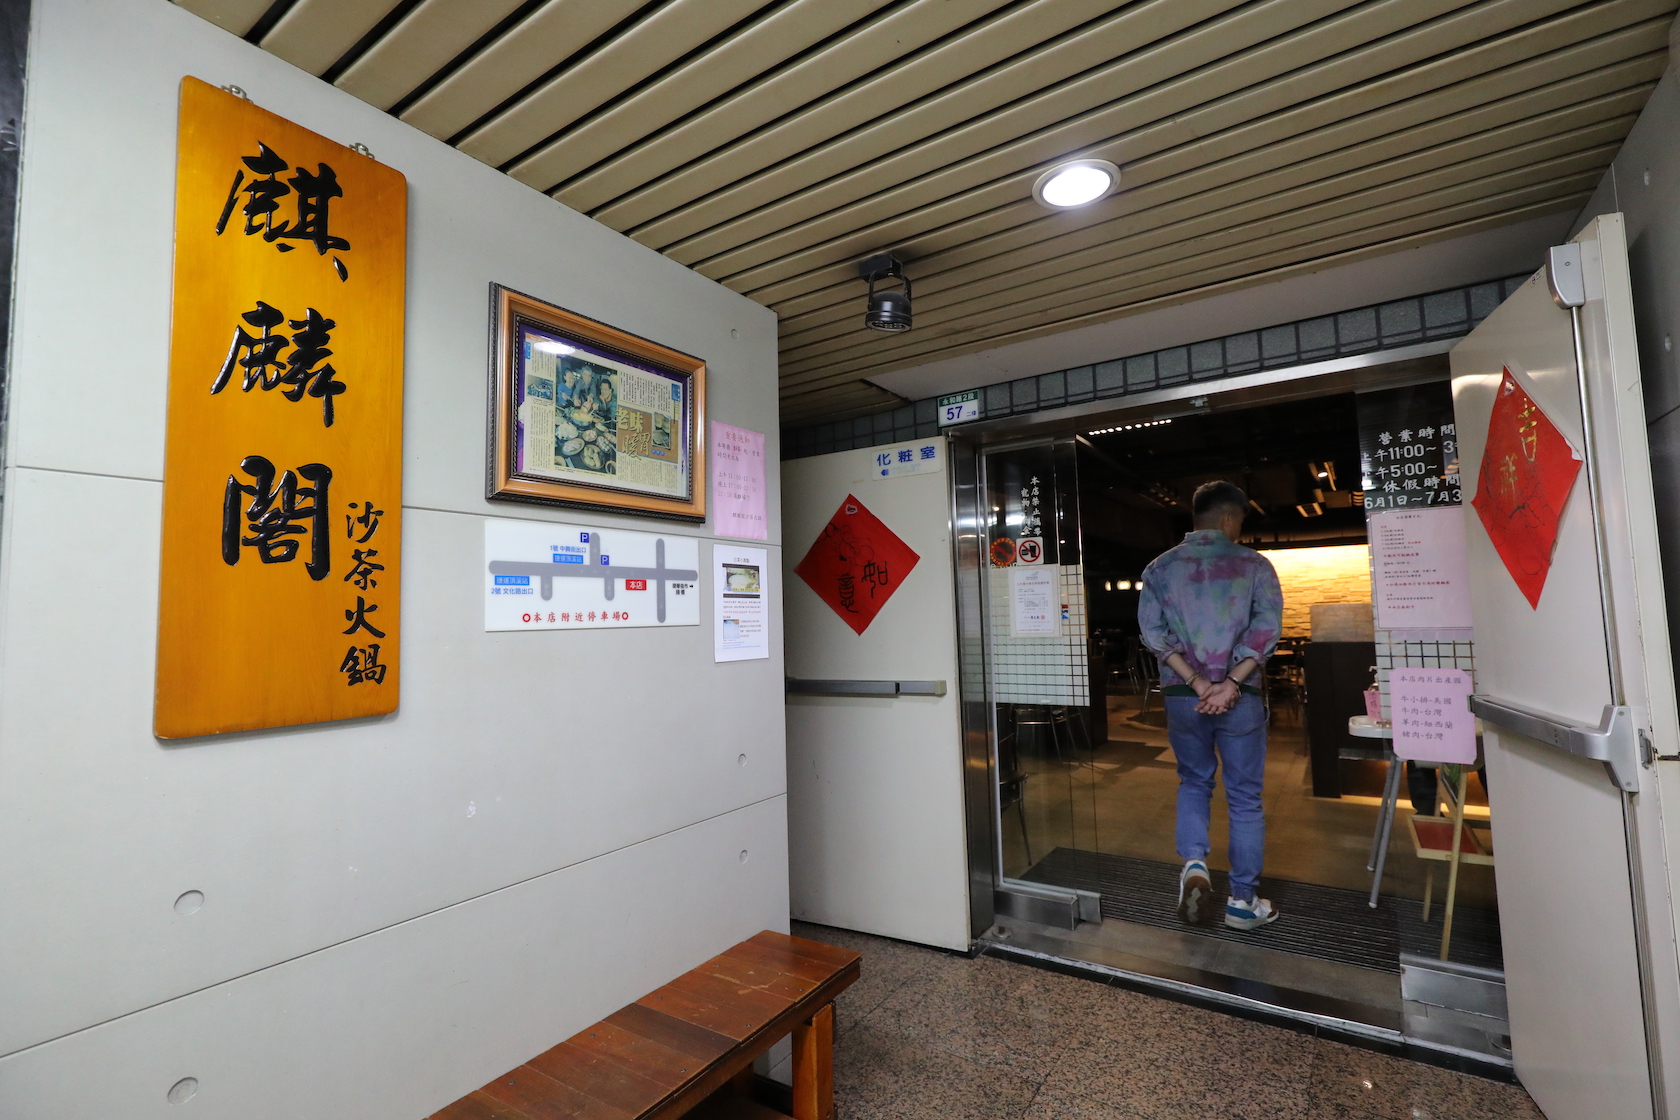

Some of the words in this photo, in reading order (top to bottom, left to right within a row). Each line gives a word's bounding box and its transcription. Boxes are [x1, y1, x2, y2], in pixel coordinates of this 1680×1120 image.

[210, 141, 350, 581] 麒麟閣
[942, 392, 975, 405] 永和路2段
[947, 405, 963, 420] 57
[1378, 424, 1455, 445] 營業時間
[876, 446, 935, 466] 化粧室
[1382, 474, 1460, 493] 休假時間
[629, 581, 643, 589] 本店
[340, 501, 386, 687] 沙茶火鍋
[533, 611, 621, 623] 本店附近停車場
[1401, 675, 1461, 684] 本店肉片出產國
[1401, 695, 1452, 705] 牛小排-美國
[1401, 707, 1442, 716] 牛肉-台灣
[1402, 718, 1453, 729] 羊肉-紐西蘭
[1402, 731, 1443, 740] 豬肉-台灣
